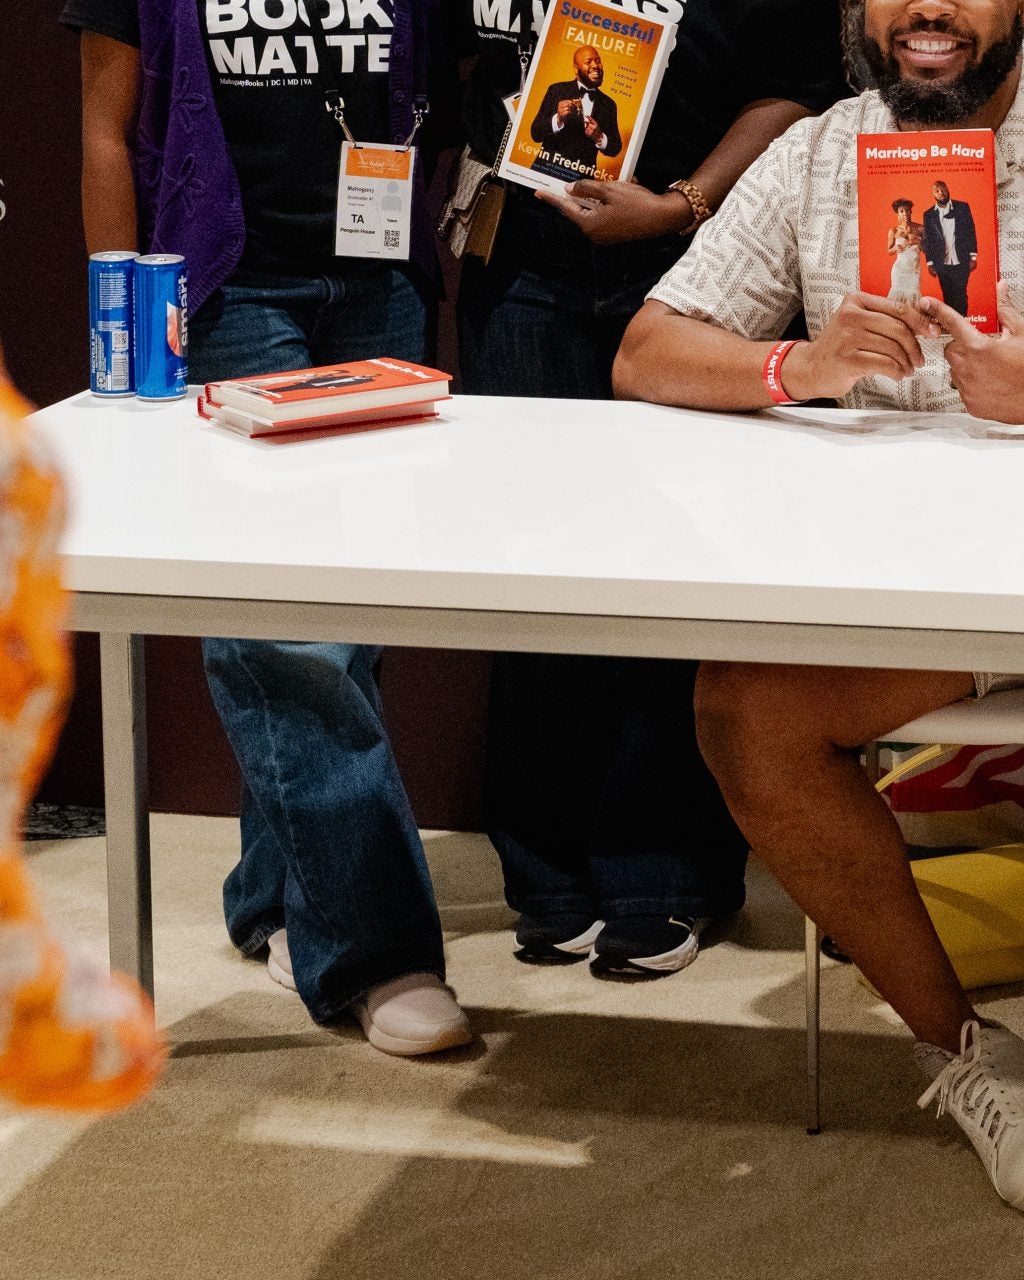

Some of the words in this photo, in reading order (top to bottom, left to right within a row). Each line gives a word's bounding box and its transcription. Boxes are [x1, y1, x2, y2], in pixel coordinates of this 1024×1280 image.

[560, 1, 655, 44] Successful
[208, 34, 393, 75] MATTE
[566, 26, 637, 57] FAILURE
[303, 78, 313, 86] VA
[517, 141, 551, 161] Kevin
[552, 152, 615, 182] Fredericks
[865, 146, 928, 161] Marriage
[930, 145, 948, 157] Be
[951, 143, 985, 159] Hard
[347, 185, 375, 194] Mahogany
[351, 214, 364, 224] TA
[768, 355, 779, 391] ARTIST
